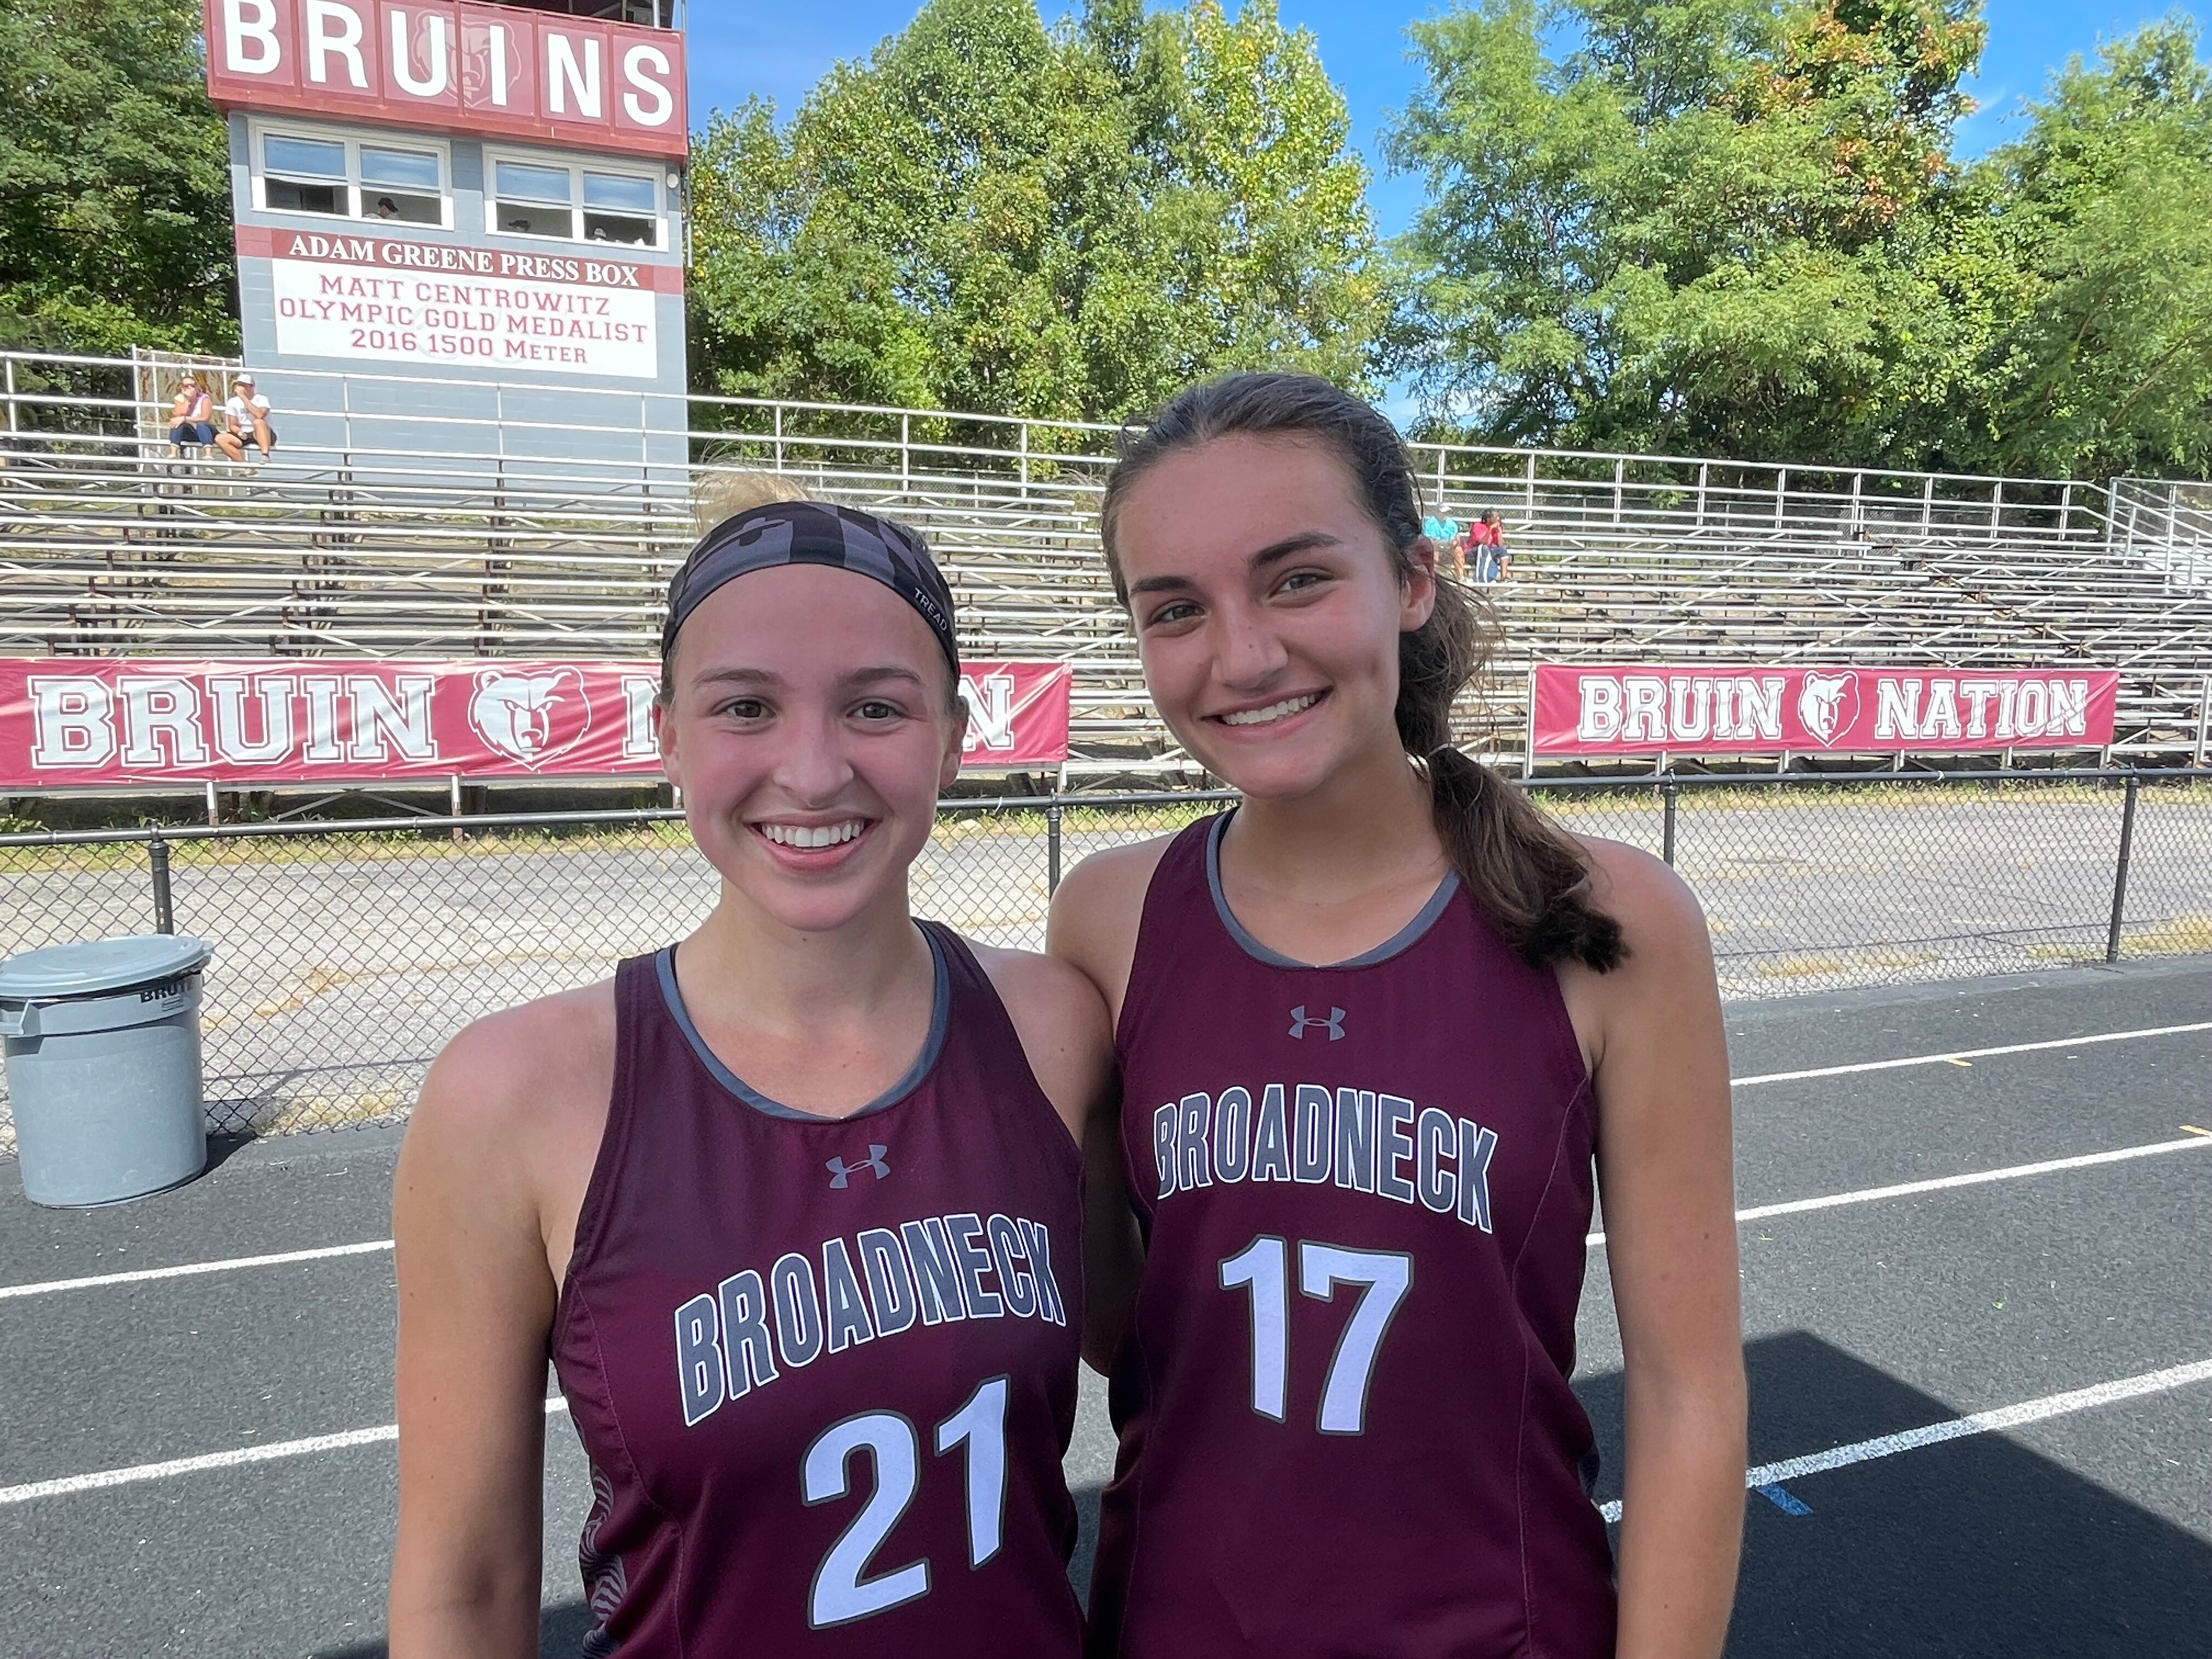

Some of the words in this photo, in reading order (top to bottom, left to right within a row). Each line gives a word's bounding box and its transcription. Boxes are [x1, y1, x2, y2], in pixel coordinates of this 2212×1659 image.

[223, 0, 673, 127] BRUINS
[289, 235, 376, 262] ADAM
[381, 242, 494, 273] GREENE
[500, 253, 579, 281] PRESS
[585, 262, 639, 286] BOX
[320, 274, 404, 299] MATT
[416, 283, 610, 315] CENTROWITZ
[280, 297, 413, 325] OLYMPIC
[425, 308, 495, 331] GOLD
[507, 314, 648, 343] MEDALIST
[351, 329, 417, 352] 2016
[427, 334, 493, 357] 1500
[915, 587, 947, 631] TREAD
[27, 675, 438, 768] BRUIN
[1577, 675, 1785, 741] BRUIN
[1874, 678, 2088, 738] NATION
[1154, 1084, 1498, 1233] BROADNECK
[674, 1212, 1066, 1426] BROADNECK
[1218, 1234, 1414, 1435] 17
[799, 1373, 1011, 1629] 21
